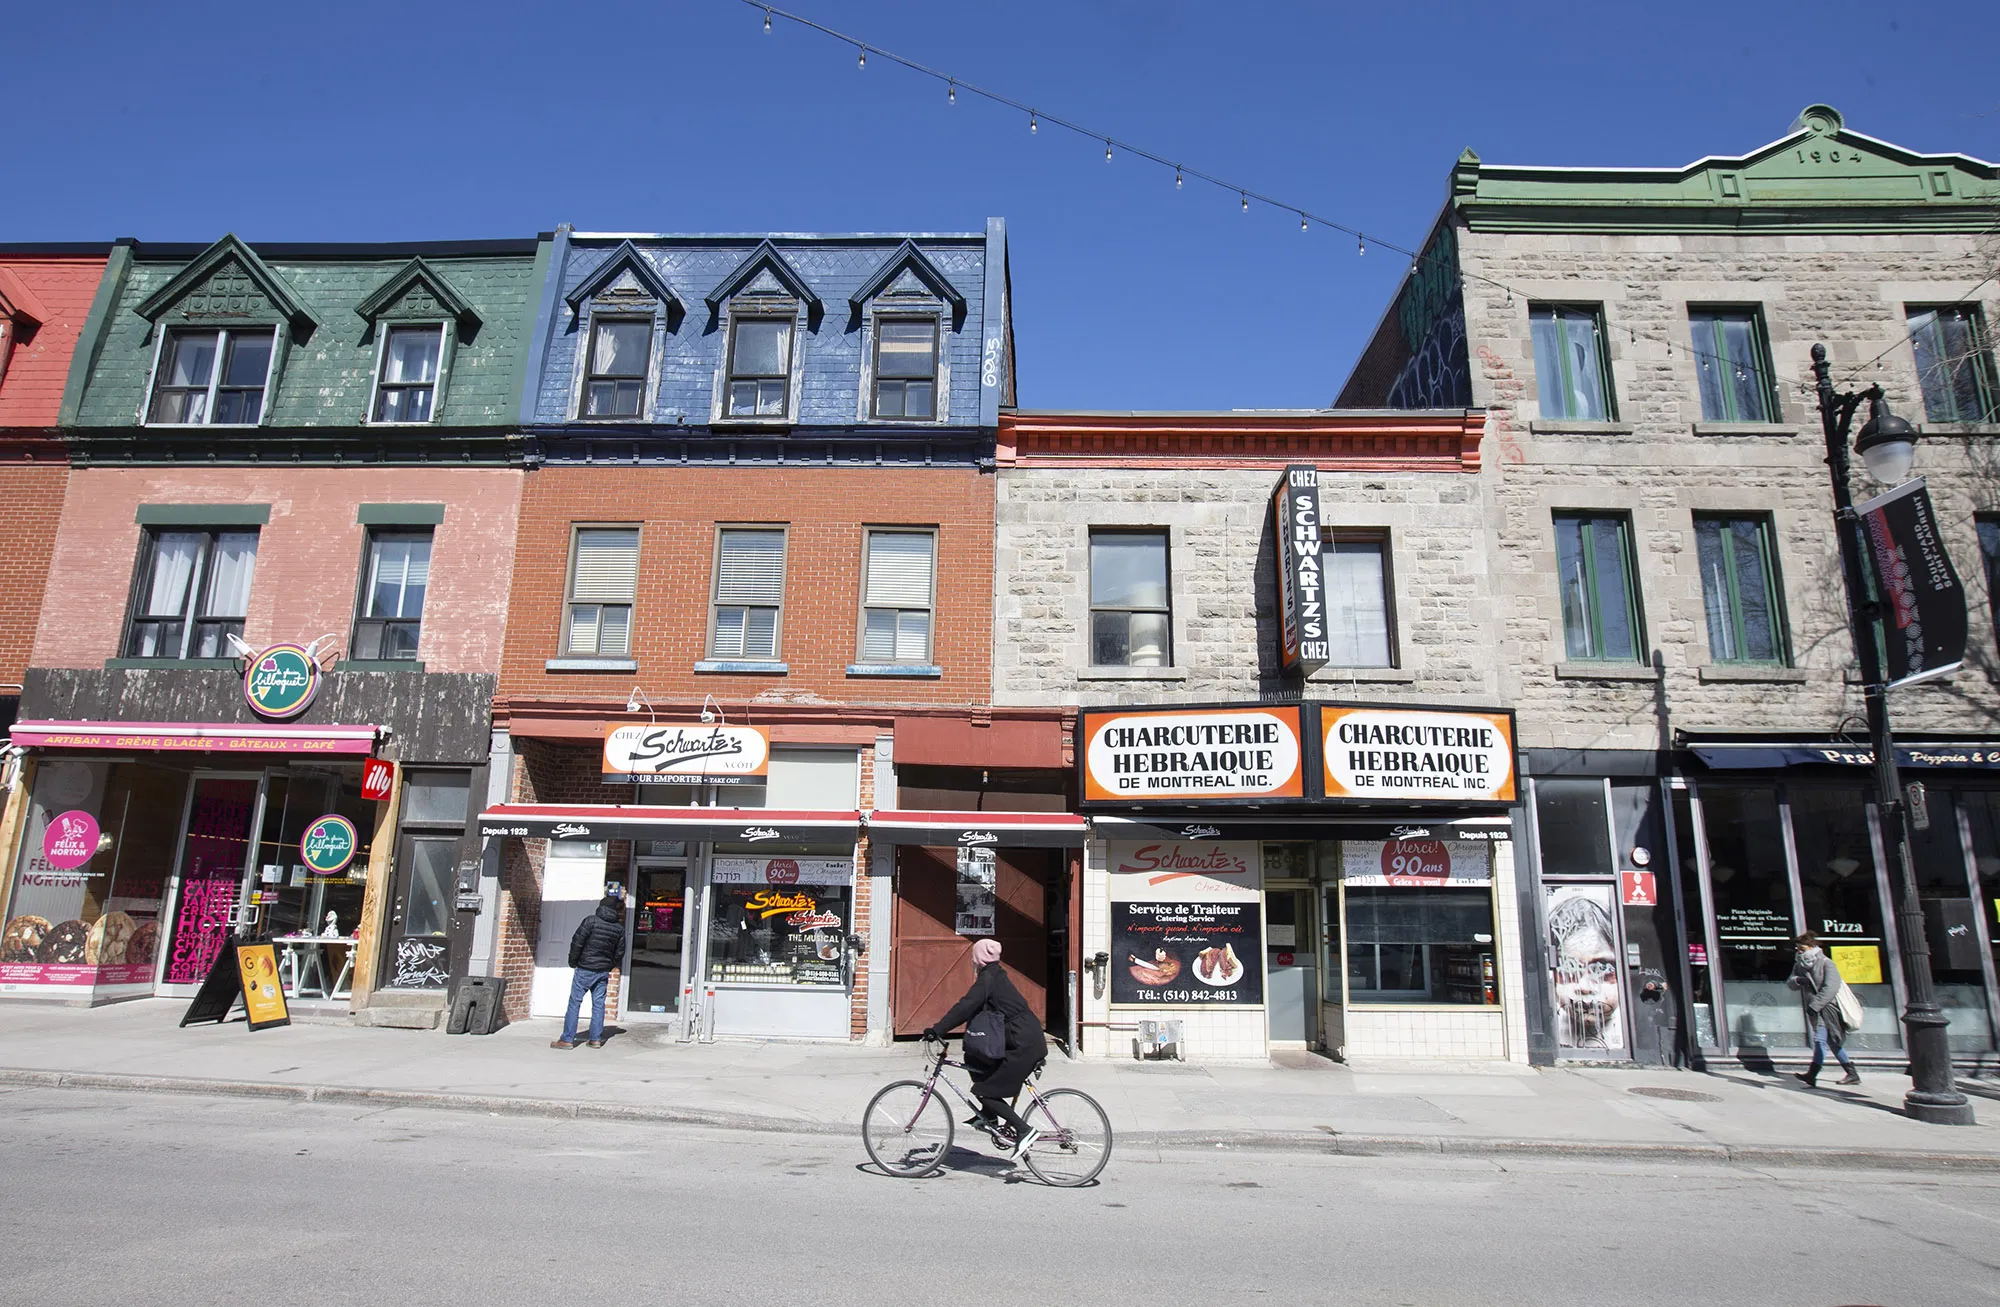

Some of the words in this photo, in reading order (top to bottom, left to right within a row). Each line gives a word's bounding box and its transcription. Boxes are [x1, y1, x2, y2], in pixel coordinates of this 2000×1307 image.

[1796, 150, 1862, 164] 1904
[1289, 470, 1317, 488] CHEZ
[1912, 495, 1953, 588] SAINT-LAURENT
[1913, 524, 1944, 591] BOULEVARD
[1293, 495, 1322, 638] SCHWARTZ'S
[1301, 641, 1329, 660] CHEZ
[257, 672, 307, 699] bilboquet
[615, 731, 642, 740] CHEZ
[1104, 723, 1279, 748] CHARCUTERIE
[1339, 723, 1494, 749] CHARCUTERIE
[44, 736, 100, 745] ARTISAN
[116, 736, 160, 747] CRÈME
[163, 737, 214, 748] GLACÉE
[229, 738, 287, 750] GÂTEAUX
[302, 739, 335, 750] CAFÉ
[629, 728, 742, 772] Schwartz's
[1113, 750, 1273, 775] HEBRAIQUE
[1349, 751, 1490, 776] HEBRAIQUE
[1909, 751, 1969, 765] Pizzeria
[1971, 753, 1983, 763] &
[365, 765, 391, 797] illy
[627, 774, 652, 783] POUR
[653, 775, 702, 783] EMPORTER
[1119, 778, 1140, 789] DE
[1147, 774, 1235, 789] MONTRÉAL
[1241, 774, 1273, 787] INC.
[1355, 775, 1375, 787] DE
[1381, 774, 1459, 789] MONTRÉAL
[1464, 777, 1490, 789] INC.
[482, 827, 508, 836] Depuis
[510, 827, 528, 836] 1928
[1459, 831, 1488, 840] Depuis
[54, 837, 77, 849] FÉLIX
[79, 841, 85, 849] &
[309, 838, 350, 857] bilboquet
[1391, 840, 1438, 855] Merci!
[50, 848, 87, 856] NORTON
[715, 859, 744, 867] Thanks!
[1118, 844, 1247, 886] Schwartz's
[1391, 856, 1423, 877] 90
[1422, 863, 1444, 873] ans
[770, 869, 785, 879] 90
[184, 885, 235, 898] CAKES
[1195, 882, 1220, 892] Chez
[745, 889, 816, 920] Schwartz's
[1129, 904, 1172, 915] Service
[1175, 904, 1189, 915] de
[1192, 904, 1241, 915] Traiteur
[178, 915, 229, 933] HOT
[1155, 915, 1188, 923] Catering
[1823, 919, 1864, 933] Pizza
[1127, 923, 1163, 933] N'importe
[1192, 923, 1228, 934] N'importe
[176, 932, 227, 940] CHOCOLAT
[788, 934, 802, 942] THE
[804, 934, 839, 943] MUSICAL
[175, 939, 225, 949] CHAUD
[1137, 990, 1161, 1000] Tél.:
[1163, 990, 1190, 1002] (514)
[1191, 991, 1238, 1001] 842-4813
